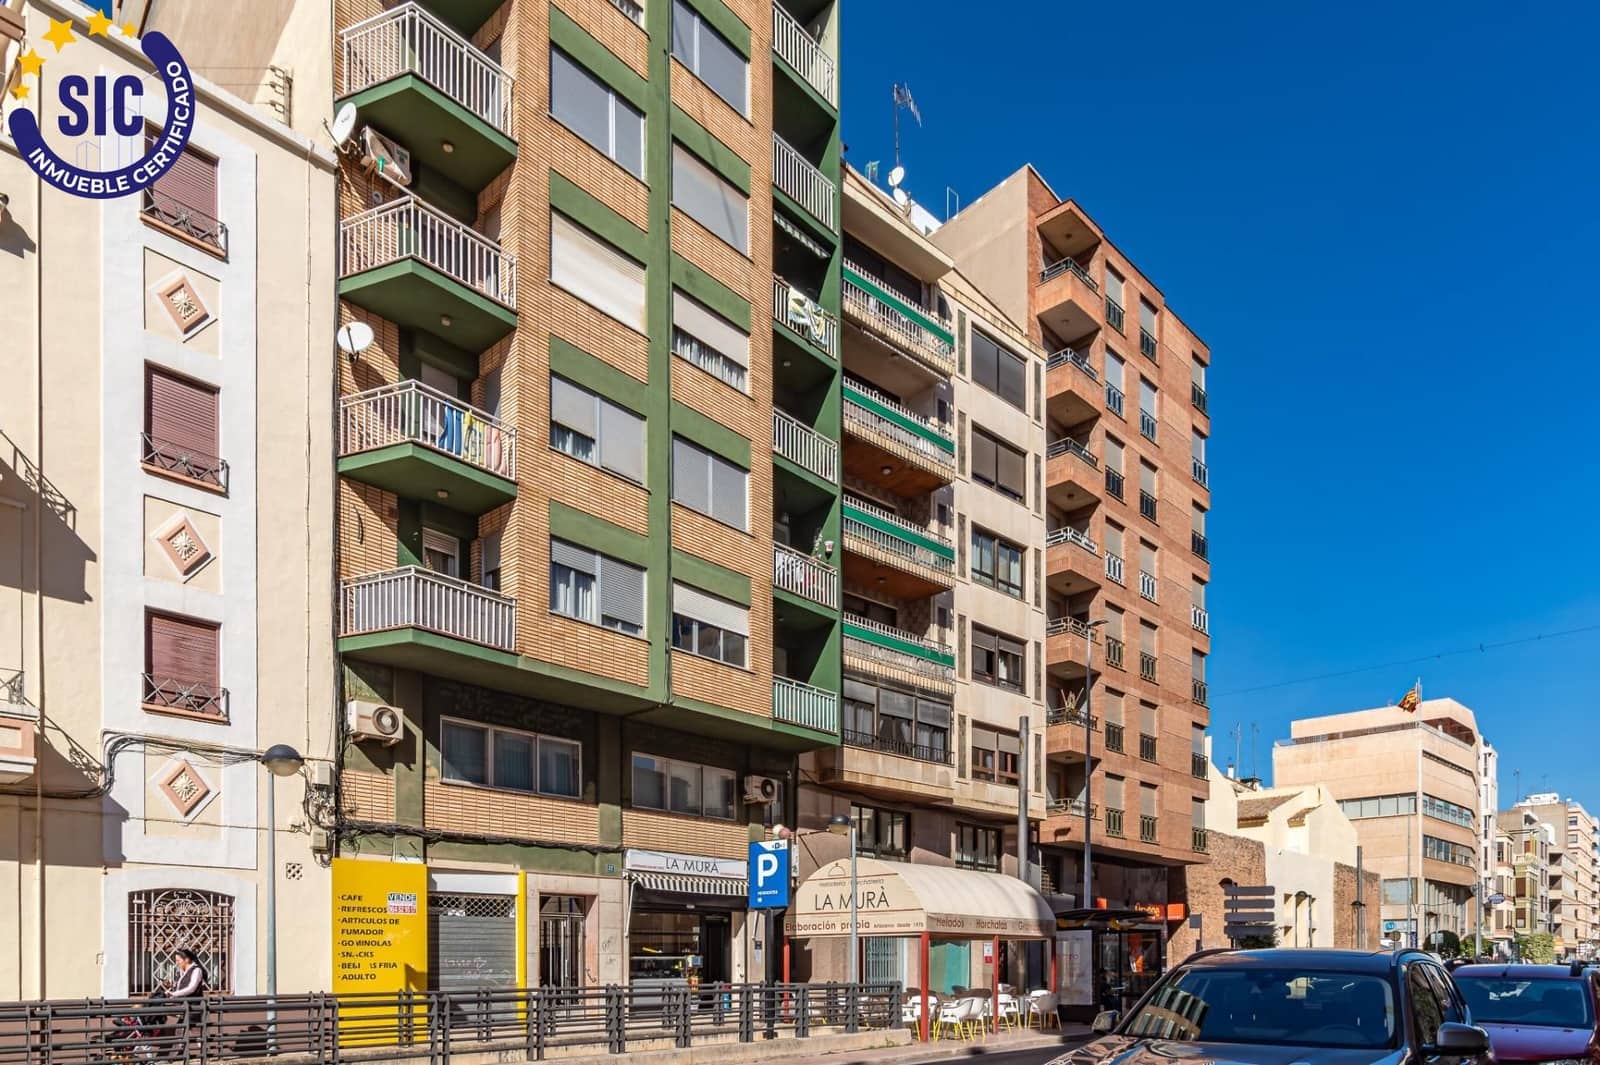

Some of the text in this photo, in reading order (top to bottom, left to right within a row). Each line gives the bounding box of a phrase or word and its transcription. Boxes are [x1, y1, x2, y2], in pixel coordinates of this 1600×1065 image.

[665, 857, 680, 871] LA
[757, 853, 778, 887] P
[815, 893, 834, 911] LA
[341, 917, 387, 925] ARTICULOS
[785, 921, 836, 932] Elaboración
[936, 917, 965, 928] Helados
[975, 919, 1008, 930] Horchatas
[341, 973, 377, 981] ADULTO
